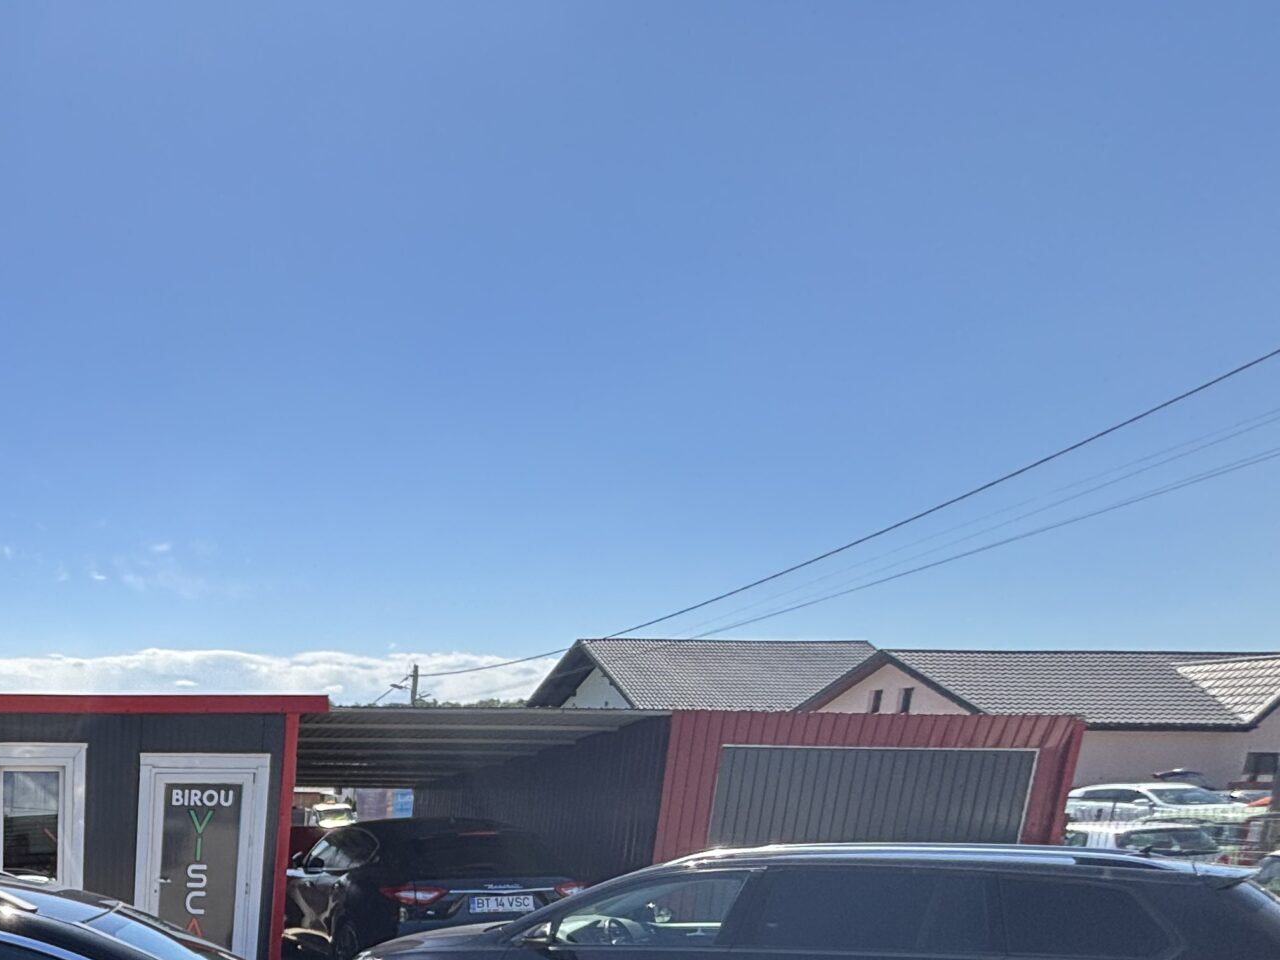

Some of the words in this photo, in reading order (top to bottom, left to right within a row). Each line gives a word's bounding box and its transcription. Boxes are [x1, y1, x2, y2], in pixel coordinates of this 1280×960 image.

[171, 789, 234, 807] BIROU
[477, 897, 490, 908] BT
[495, 897, 505, 907] 14
[508, 896, 530, 907] VSC
